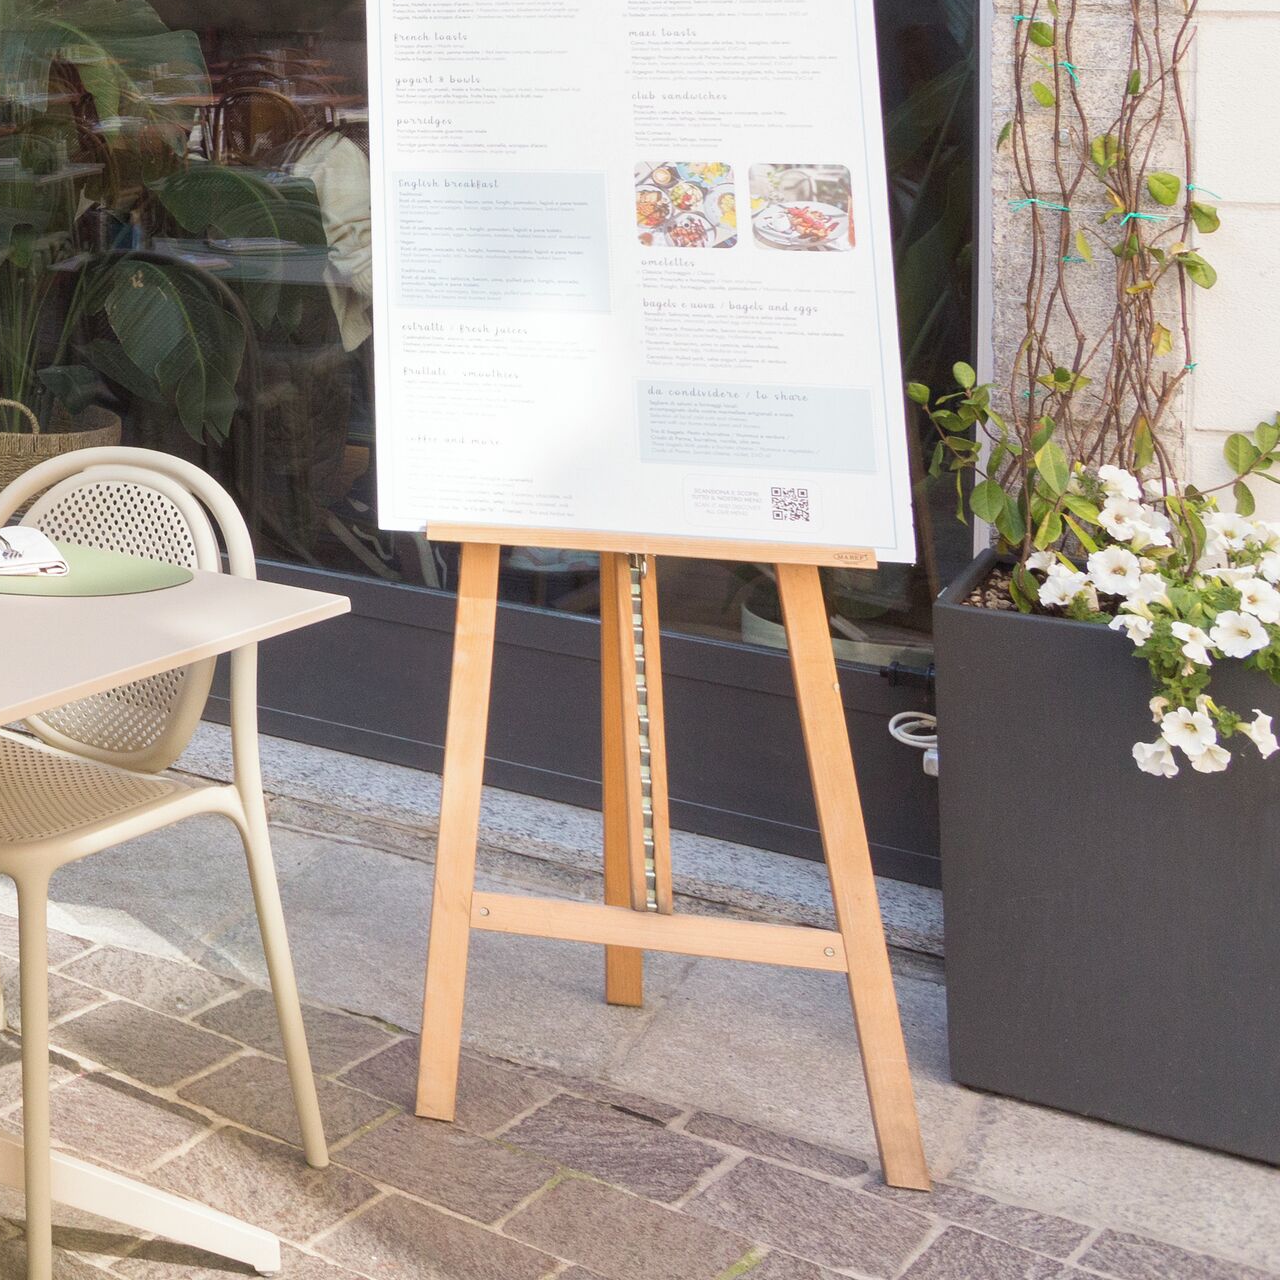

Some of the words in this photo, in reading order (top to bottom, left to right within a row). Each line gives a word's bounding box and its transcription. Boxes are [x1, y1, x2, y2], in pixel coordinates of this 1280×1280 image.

[434, 31, 468, 41] toasts
[661, 27, 697, 38] toasts
[395, 75, 433, 87] yogurt
[449, 74, 481, 84] bowls
[631, 91, 656, 101] club
[661, 90, 728, 101] sandwiches
[396, 116, 452, 128] porridges
[444, 179, 499, 191] breakfast
[641, 256, 695, 268] omelettes
[642, 297, 677, 312] bagels
[690, 302, 715, 310] uova
[728, 300, 764, 315] bagels
[767, 302, 789, 313] and
[793, 305, 818, 316] eggs
[647, 385, 664, 396] da
[667, 386, 740, 399] condividere
[756, 389, 768, 400] to
[773, 390, 809, 402] share
